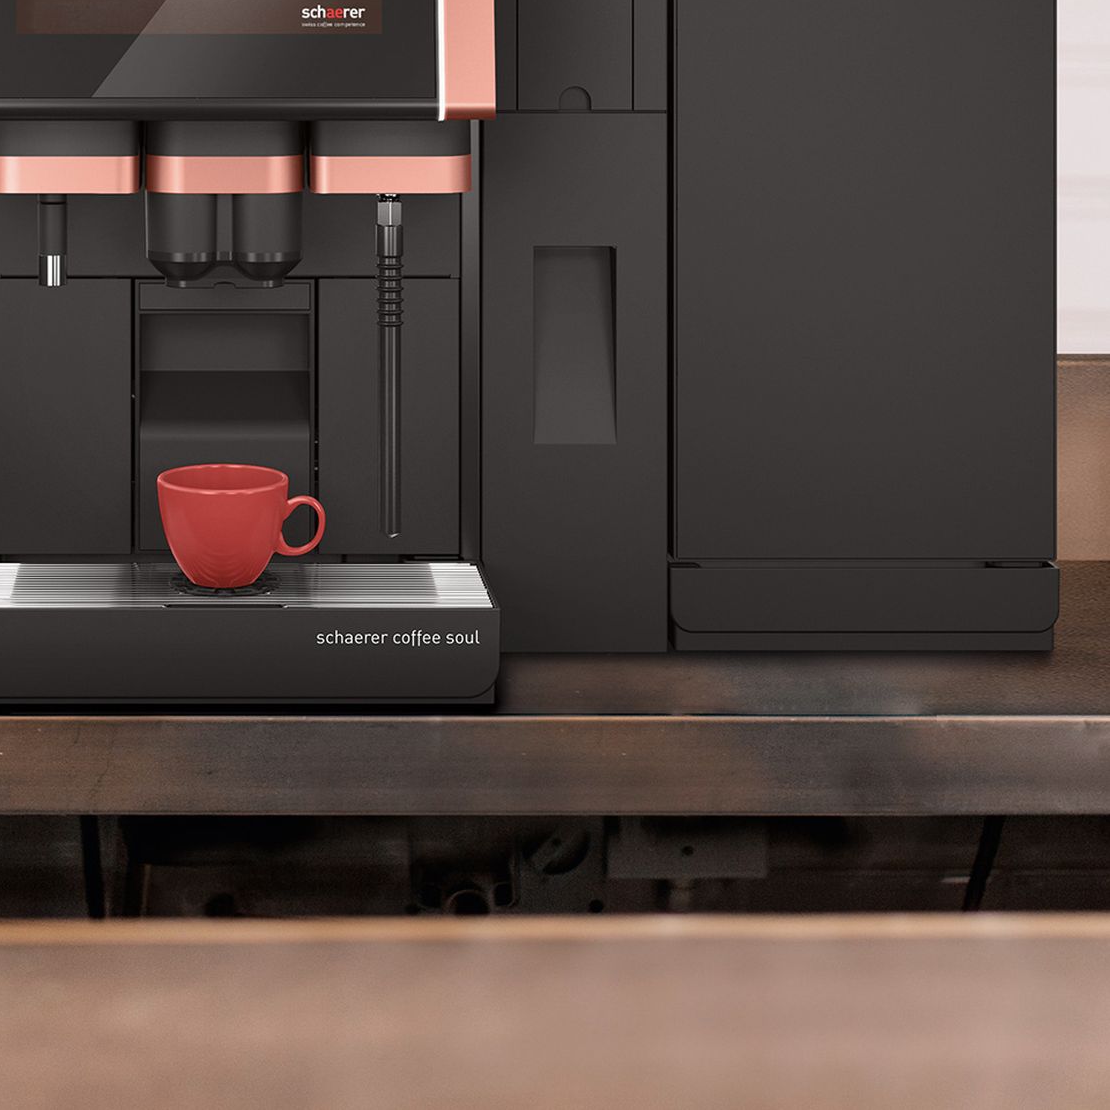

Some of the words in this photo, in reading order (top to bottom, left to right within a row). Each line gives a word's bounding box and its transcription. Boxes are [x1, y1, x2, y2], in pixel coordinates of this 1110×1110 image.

[301, 4, 366, 19] schaerer
[316, 630, 389, 645] schaerer
[392, 630, 441, 647] coffee
[445, 630, 480, 645] soul
